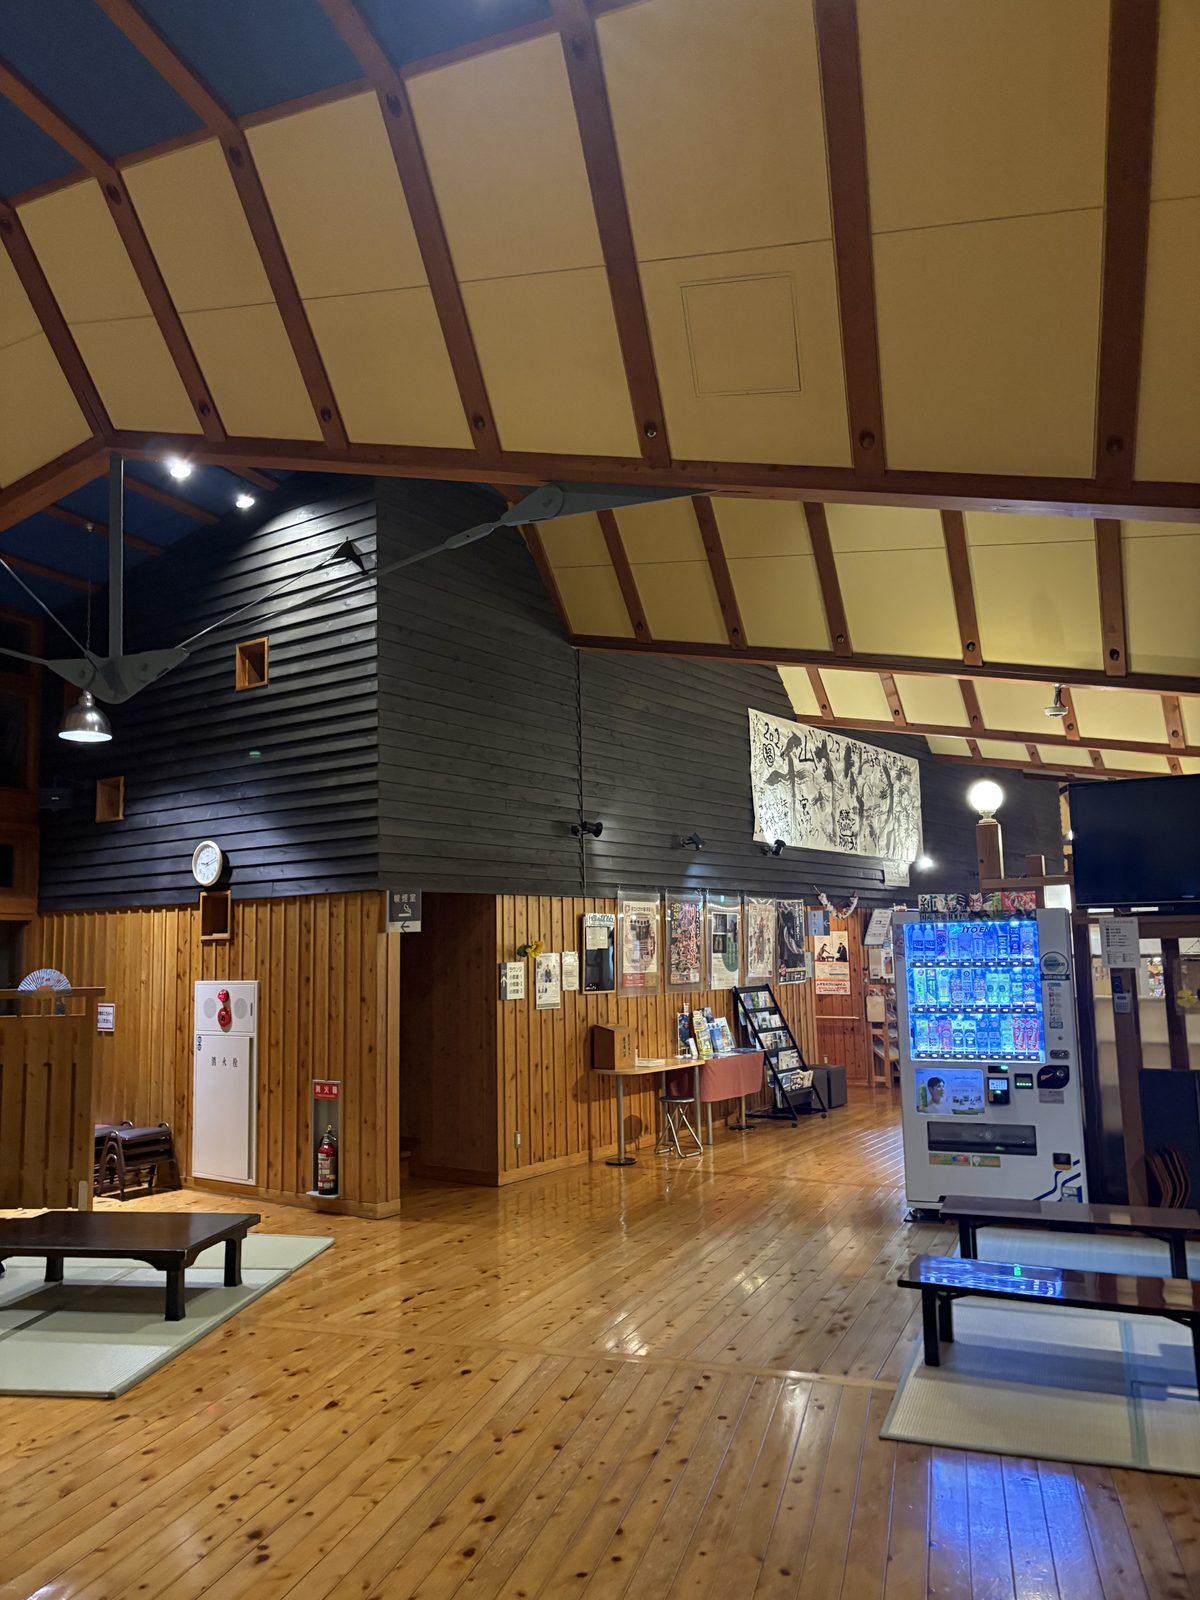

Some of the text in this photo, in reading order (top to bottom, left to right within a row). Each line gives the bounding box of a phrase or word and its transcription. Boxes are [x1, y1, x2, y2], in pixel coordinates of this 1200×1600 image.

[962, 926, 978, 934] ITO
[211, 1056, 239, 1068] 消火栓
[315, 1084, 338, 1094] 消火器
